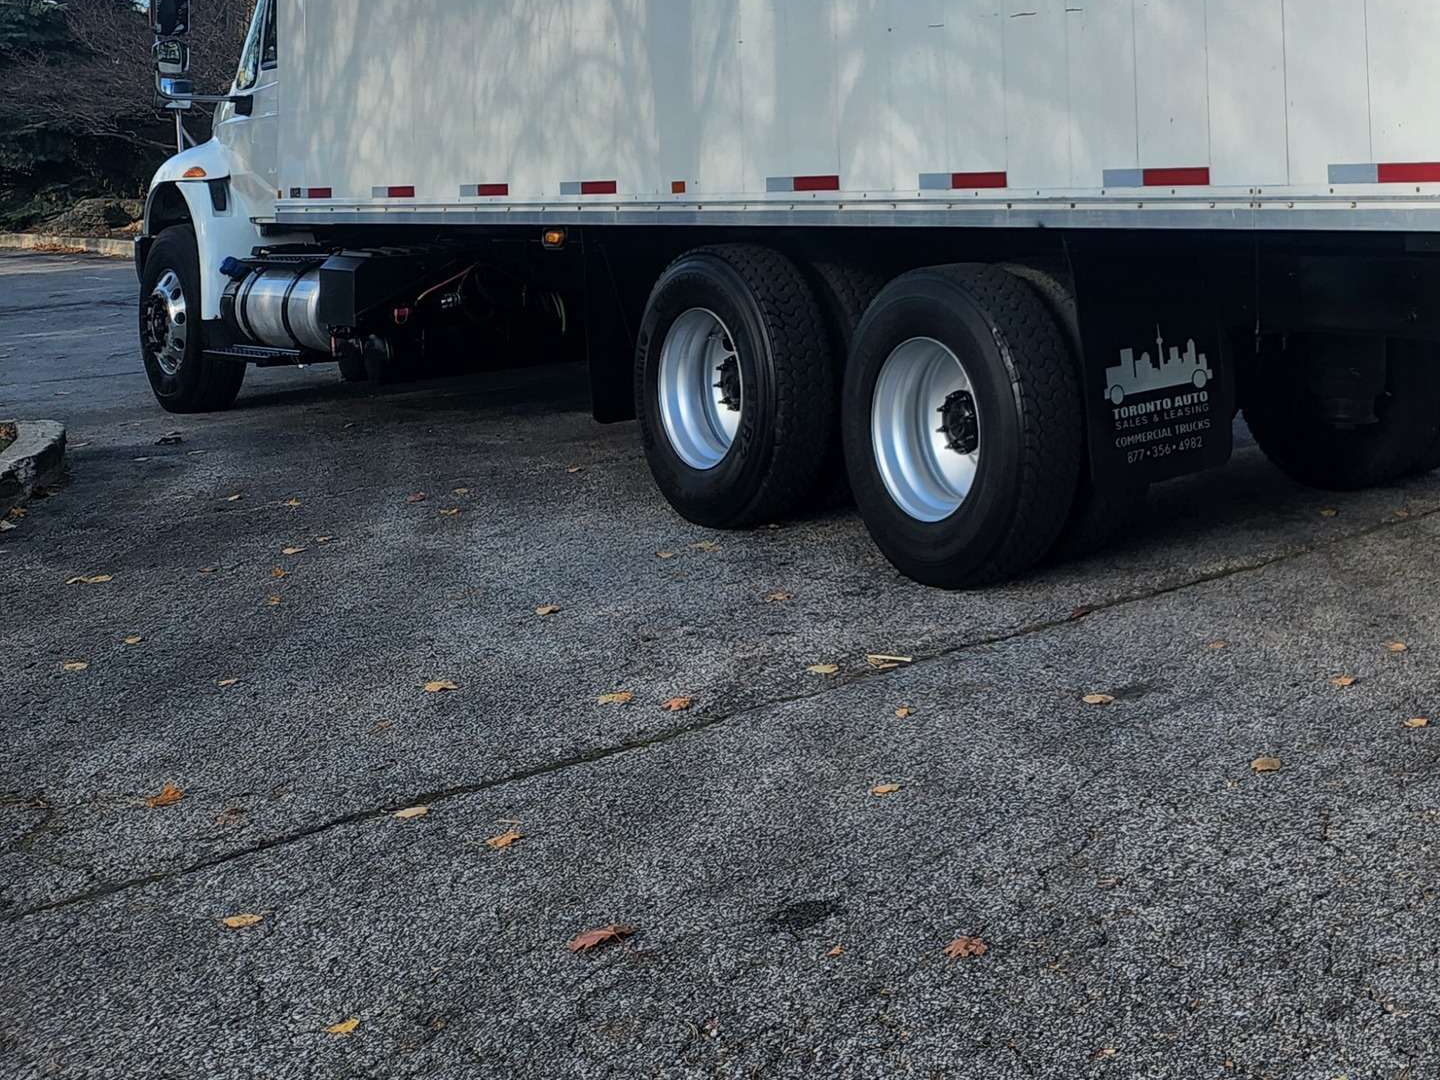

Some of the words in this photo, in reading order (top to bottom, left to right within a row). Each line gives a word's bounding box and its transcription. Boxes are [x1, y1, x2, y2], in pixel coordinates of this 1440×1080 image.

[1112, 399, 1171, 420] TORONTO
[1174, 391, 1208, 407] AUTO
[1115, 418, 1148, 430] SALES
[1153, 414, 1159, 422] &
[1164, 403, 1209, 420] LEASING
[1115, 427, 1172, 448] COMMERCIAL
[1175, 419, 1211, 434] TRUCKS
